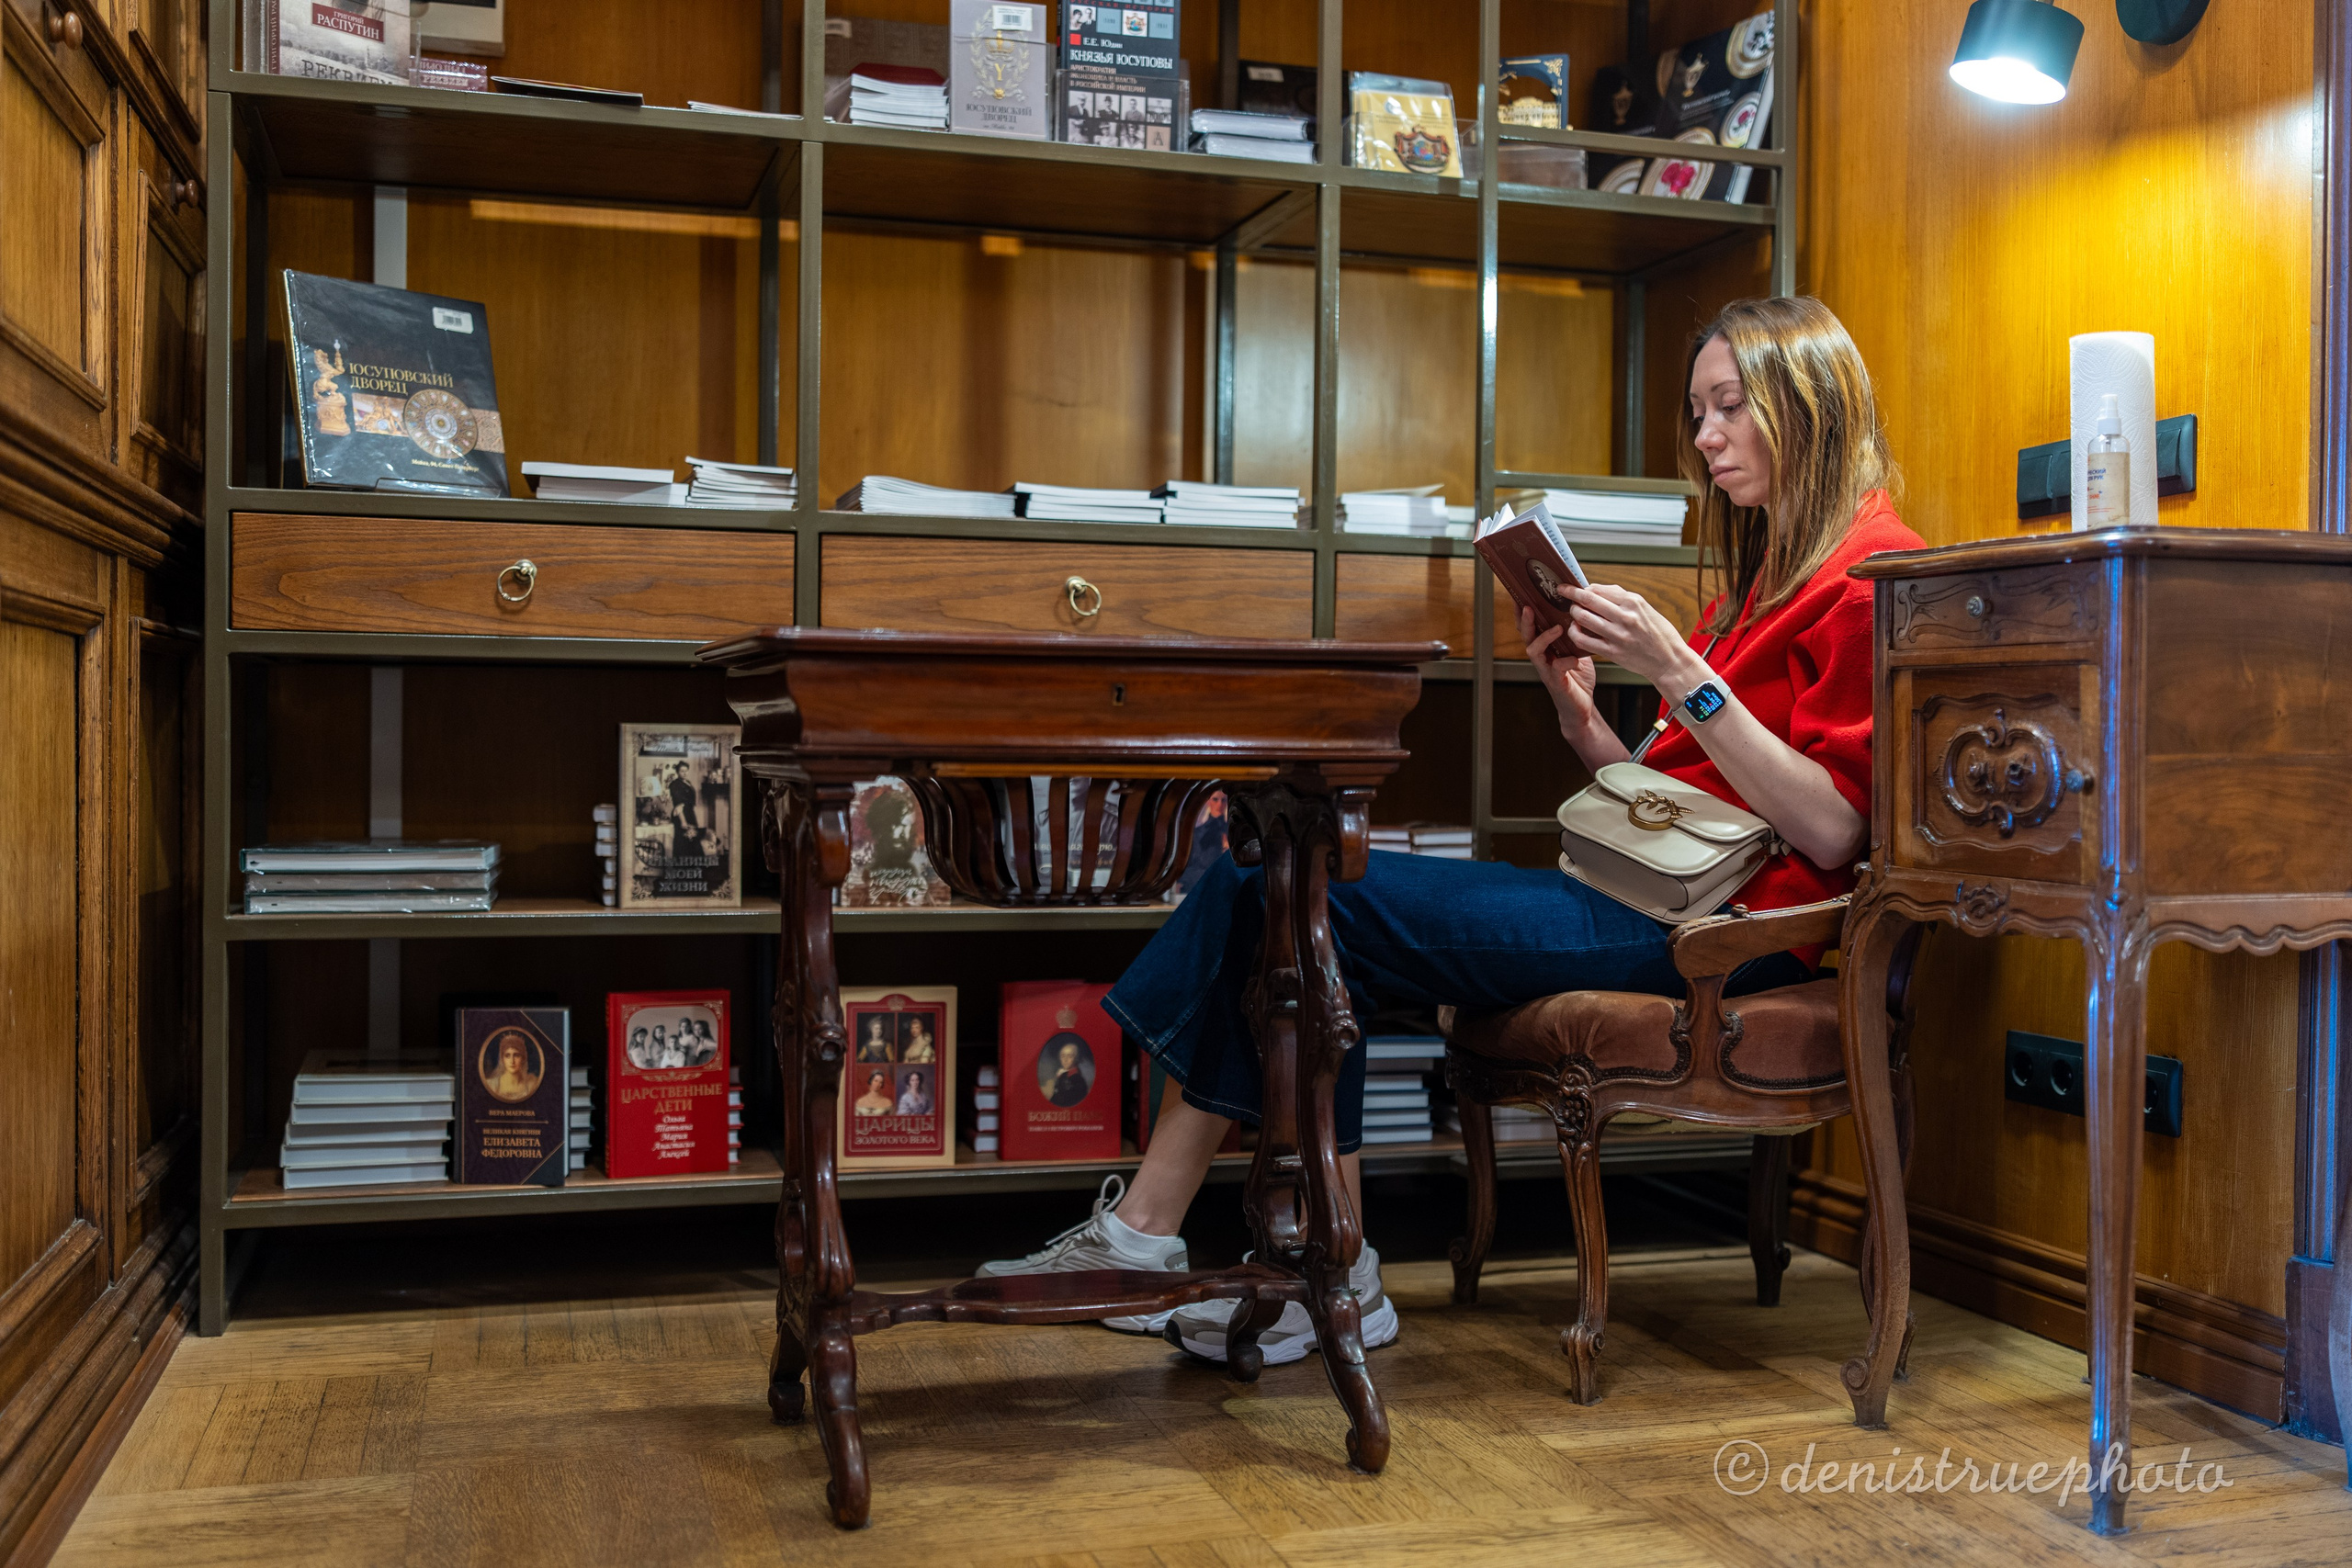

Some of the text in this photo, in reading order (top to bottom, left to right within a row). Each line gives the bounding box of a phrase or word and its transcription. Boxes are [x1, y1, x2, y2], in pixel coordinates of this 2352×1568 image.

[334, 11, 365, 25] ГРИГОРИЙ
[317, 13, 379, 40] РАСПУТИН
[1069, 50, 1114, 64] КНЯЗЬЯ
[1116, 54, 1173, 69] ЮСУПОВЫ
[966, 103, 1032, 117] ЮСУПОВСКИЙ
[349, 363, 454, 388] ЮСУПОВСКИЙ
[350, 376, 409, 396] ДВОРЕЦ
[663, 868, 703, 879] МОЕЙ
[659, 882, 708, 892] ЖИЗНИ
[621, 1083, 724, 1104] ЦАРСТВЕННЫЕ
[654, 1100, 693, 1115] ДЕТИ
[854, 1117, 936, 1135] ЦАРИЦЫ
[483, 1137, 542, 1147] ЕЛИЗАВЕТА
[854, 1135, 936, 1145] ЗОЛОТОГО ВЕКА
[481, 1147, 544, 1159] ФЕДОРОВНА
